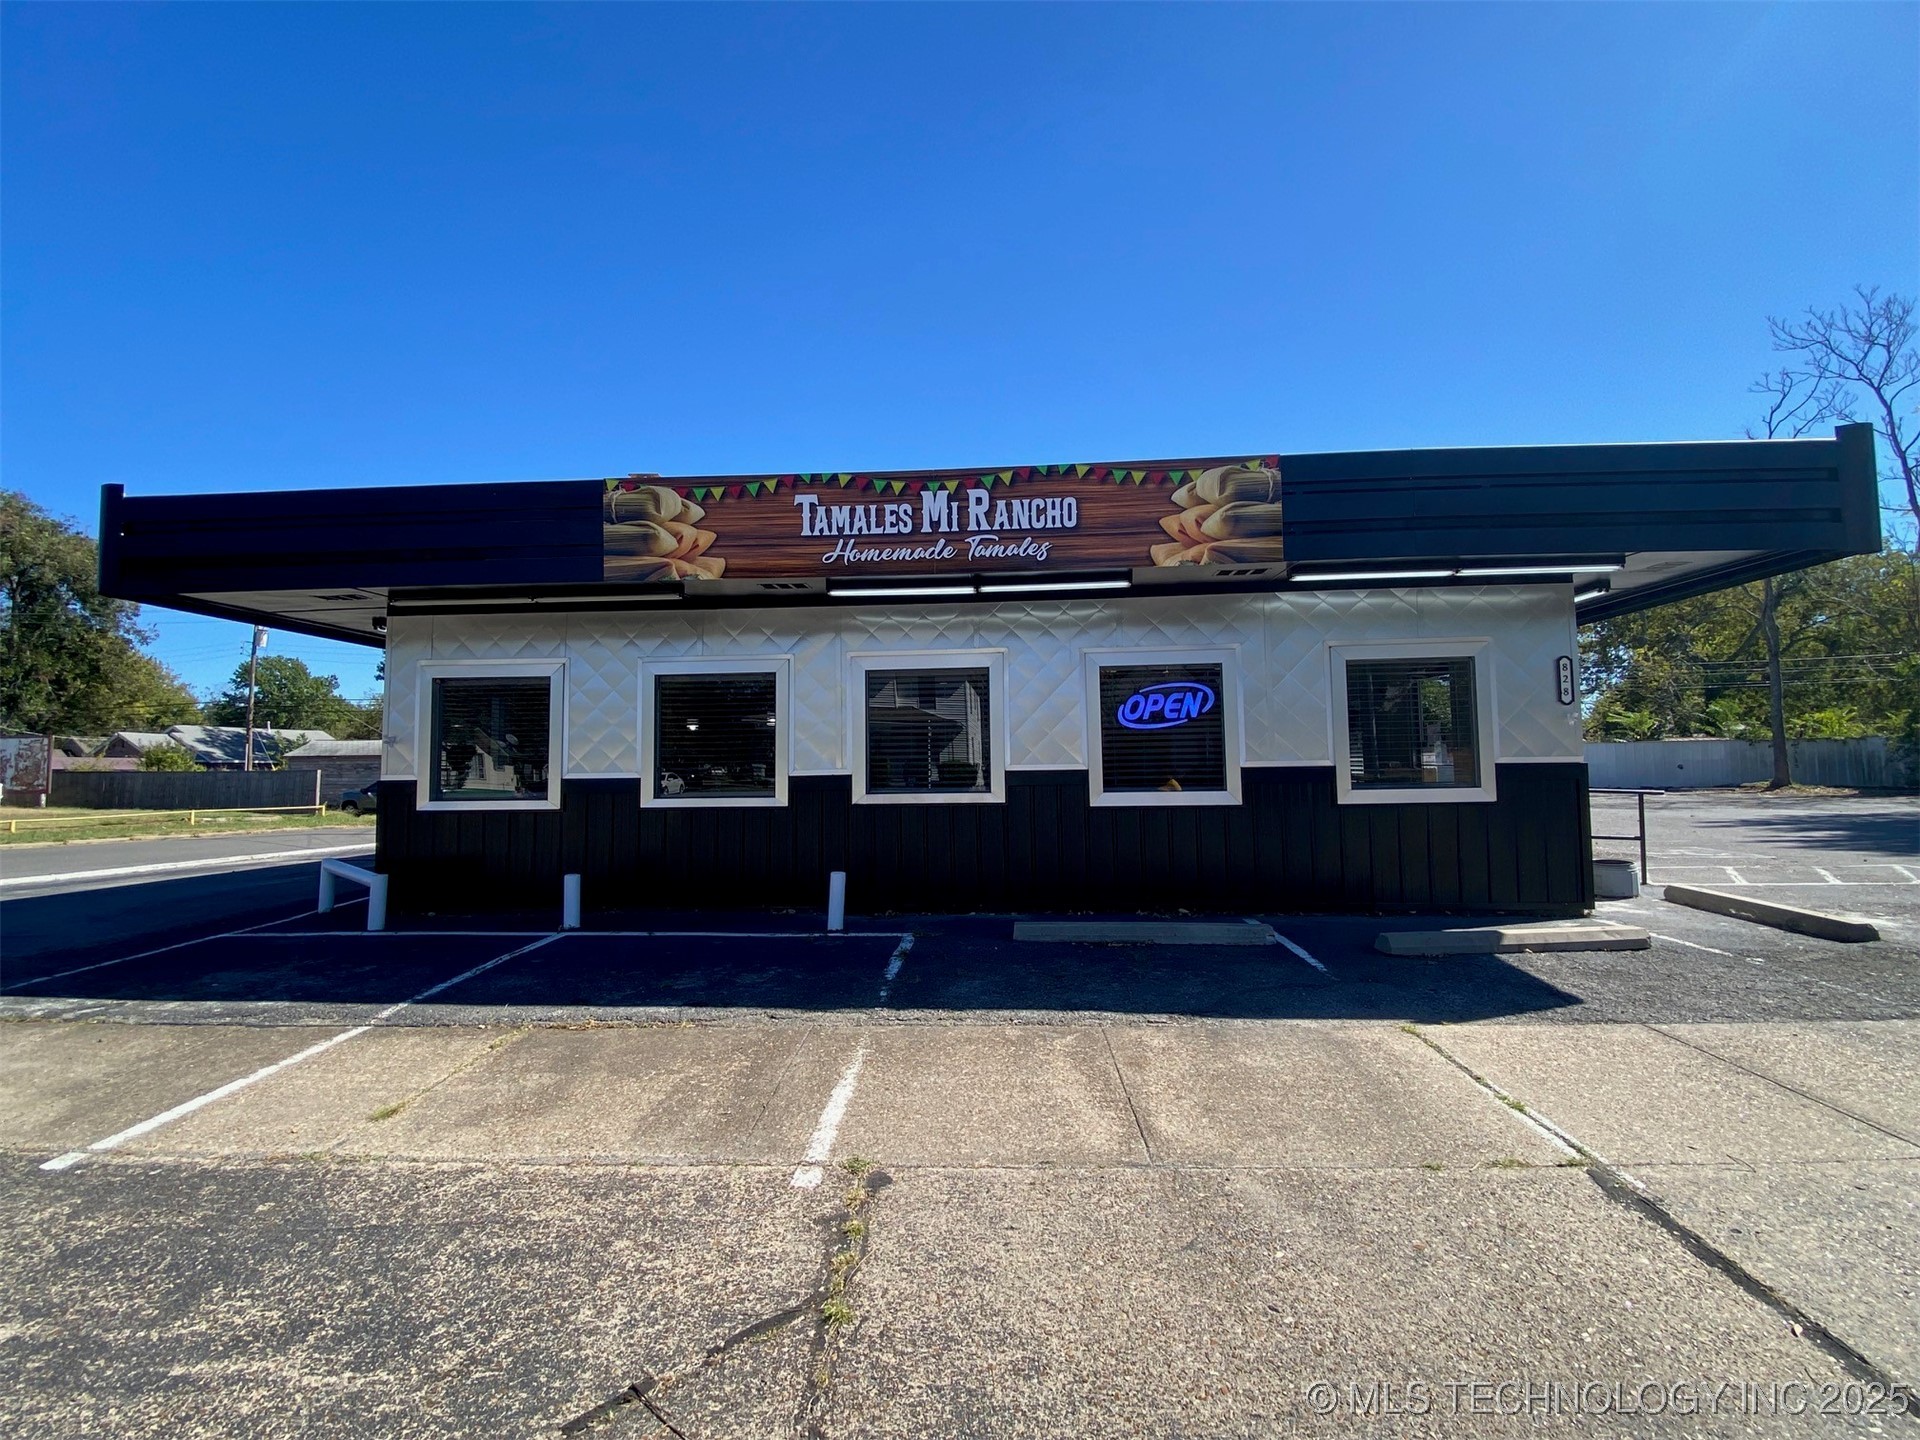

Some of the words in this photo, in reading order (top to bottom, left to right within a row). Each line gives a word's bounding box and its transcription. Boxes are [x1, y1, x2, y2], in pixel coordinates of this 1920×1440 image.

[794, 494, 913, 536] TAMALES
[966, 488, 1077, 531] RANCHO
[822, 538, 957, 565] Homemade
[964, 534, 1052, 561] Tamales
[1562, 663, 1570, 696] 828
[1124, 691, 1203, 720] OPEN
